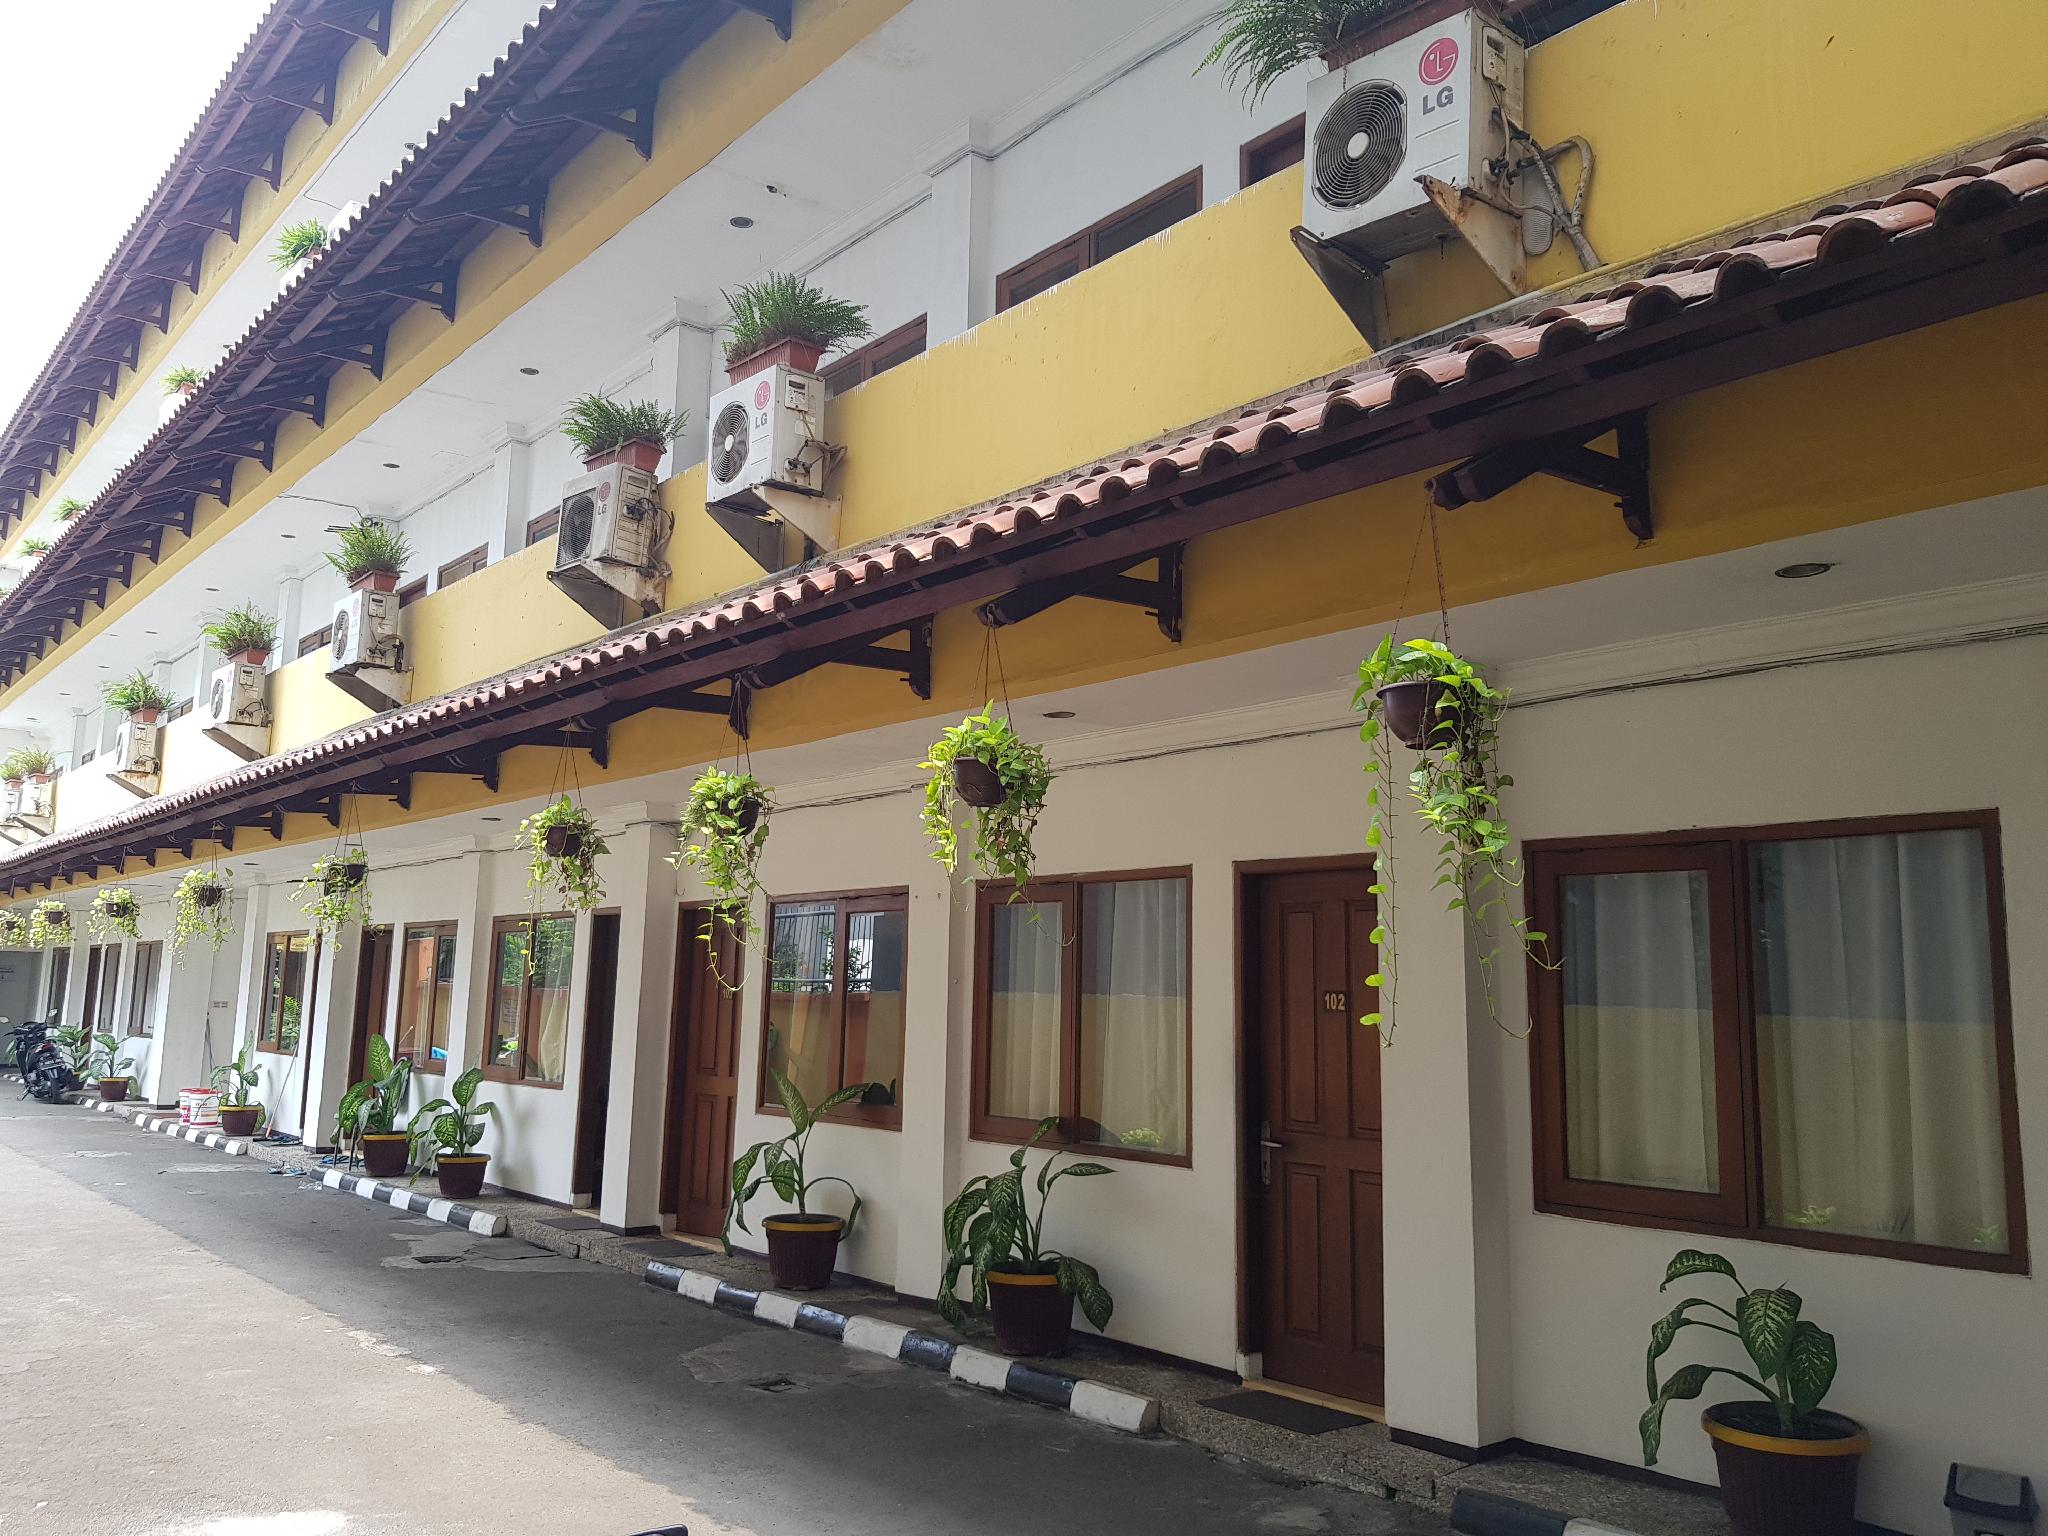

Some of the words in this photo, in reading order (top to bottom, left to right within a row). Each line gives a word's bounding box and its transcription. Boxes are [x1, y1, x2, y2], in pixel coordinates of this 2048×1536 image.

[1422, 85, 1454, 116] LG
[755, 412, 768, 429] LG
[597, 503, 607, 516] LG
[1325, 992, 1346, 1011] 102
